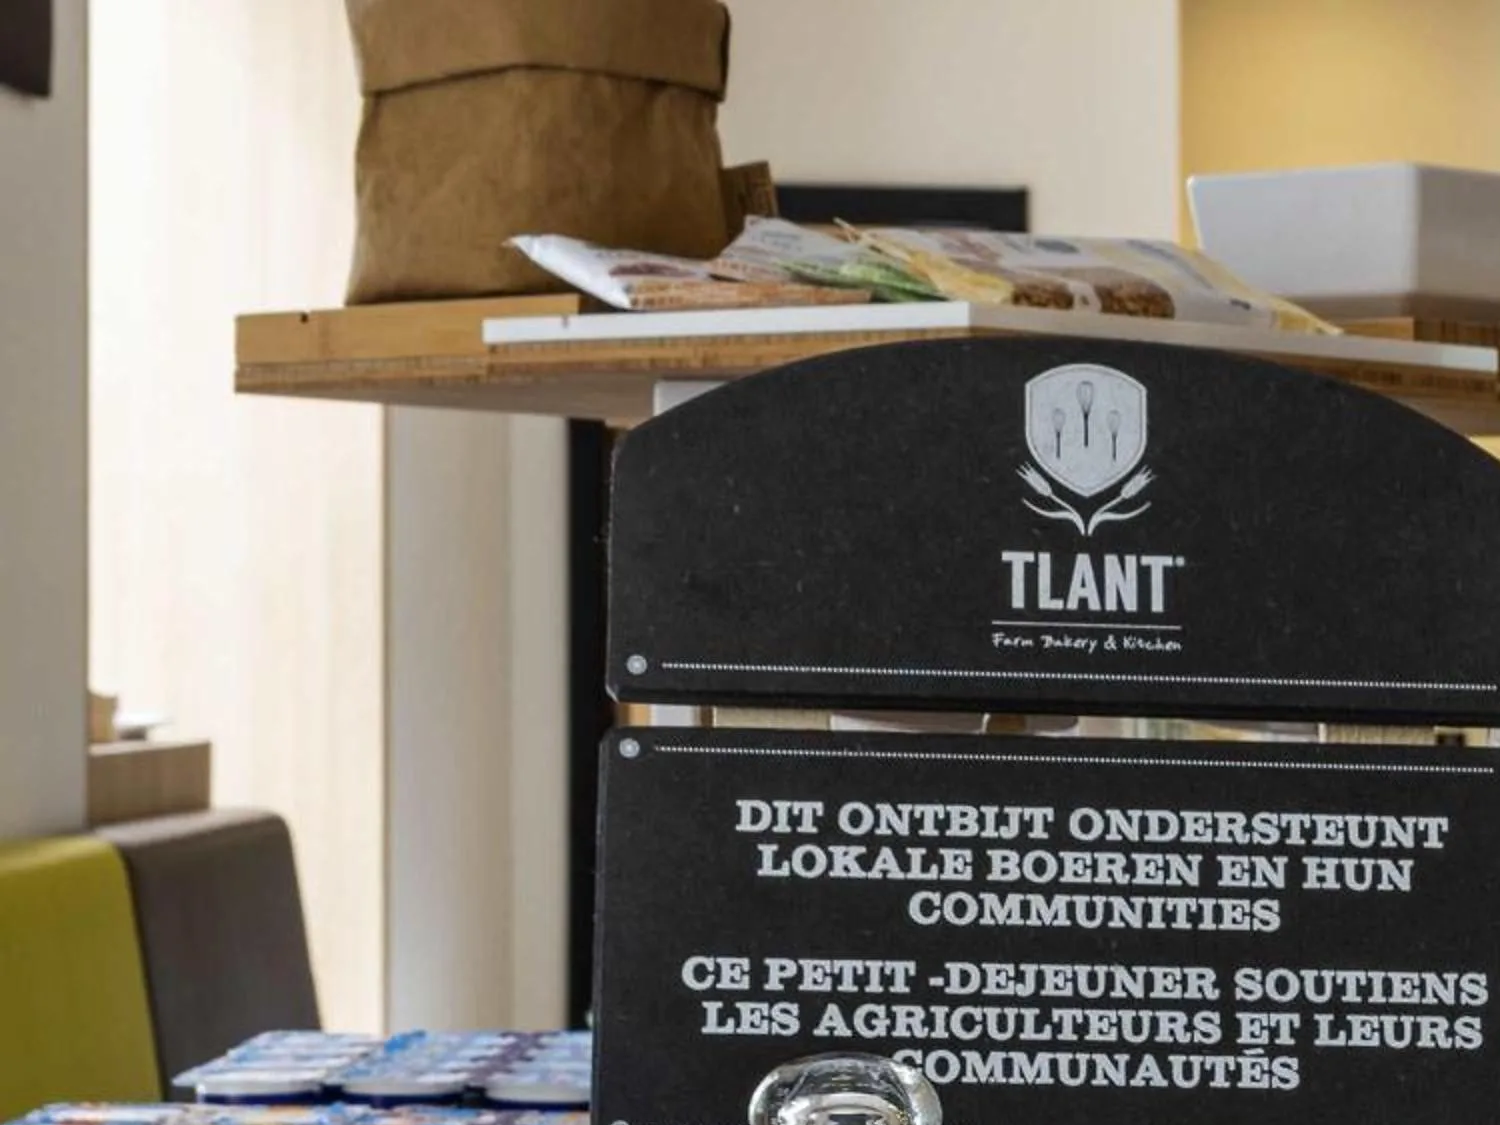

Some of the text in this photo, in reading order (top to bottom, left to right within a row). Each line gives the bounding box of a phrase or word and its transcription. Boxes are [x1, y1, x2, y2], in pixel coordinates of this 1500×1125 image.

[1002, 551, 1173, 612] TLANT
[992, 632, 1181, 653] Farm Bakery & Kitchen
[736, 800, 1449, 849] DIT ONTBIJT ONDERSTEUNT
[758, 844, 1413, 891] LOKALE BOEREN EN HUN
[909, 891, 1280, 931] COMMUNITIES
[682, 956, 749, 990] CE
[764, 958, 915, 993] PETIT
[1235, 968, 1488, 1005] SOUTIENS
[702, 1002, 1482, 1049] LES AGRICULTEURS ET LEURS
